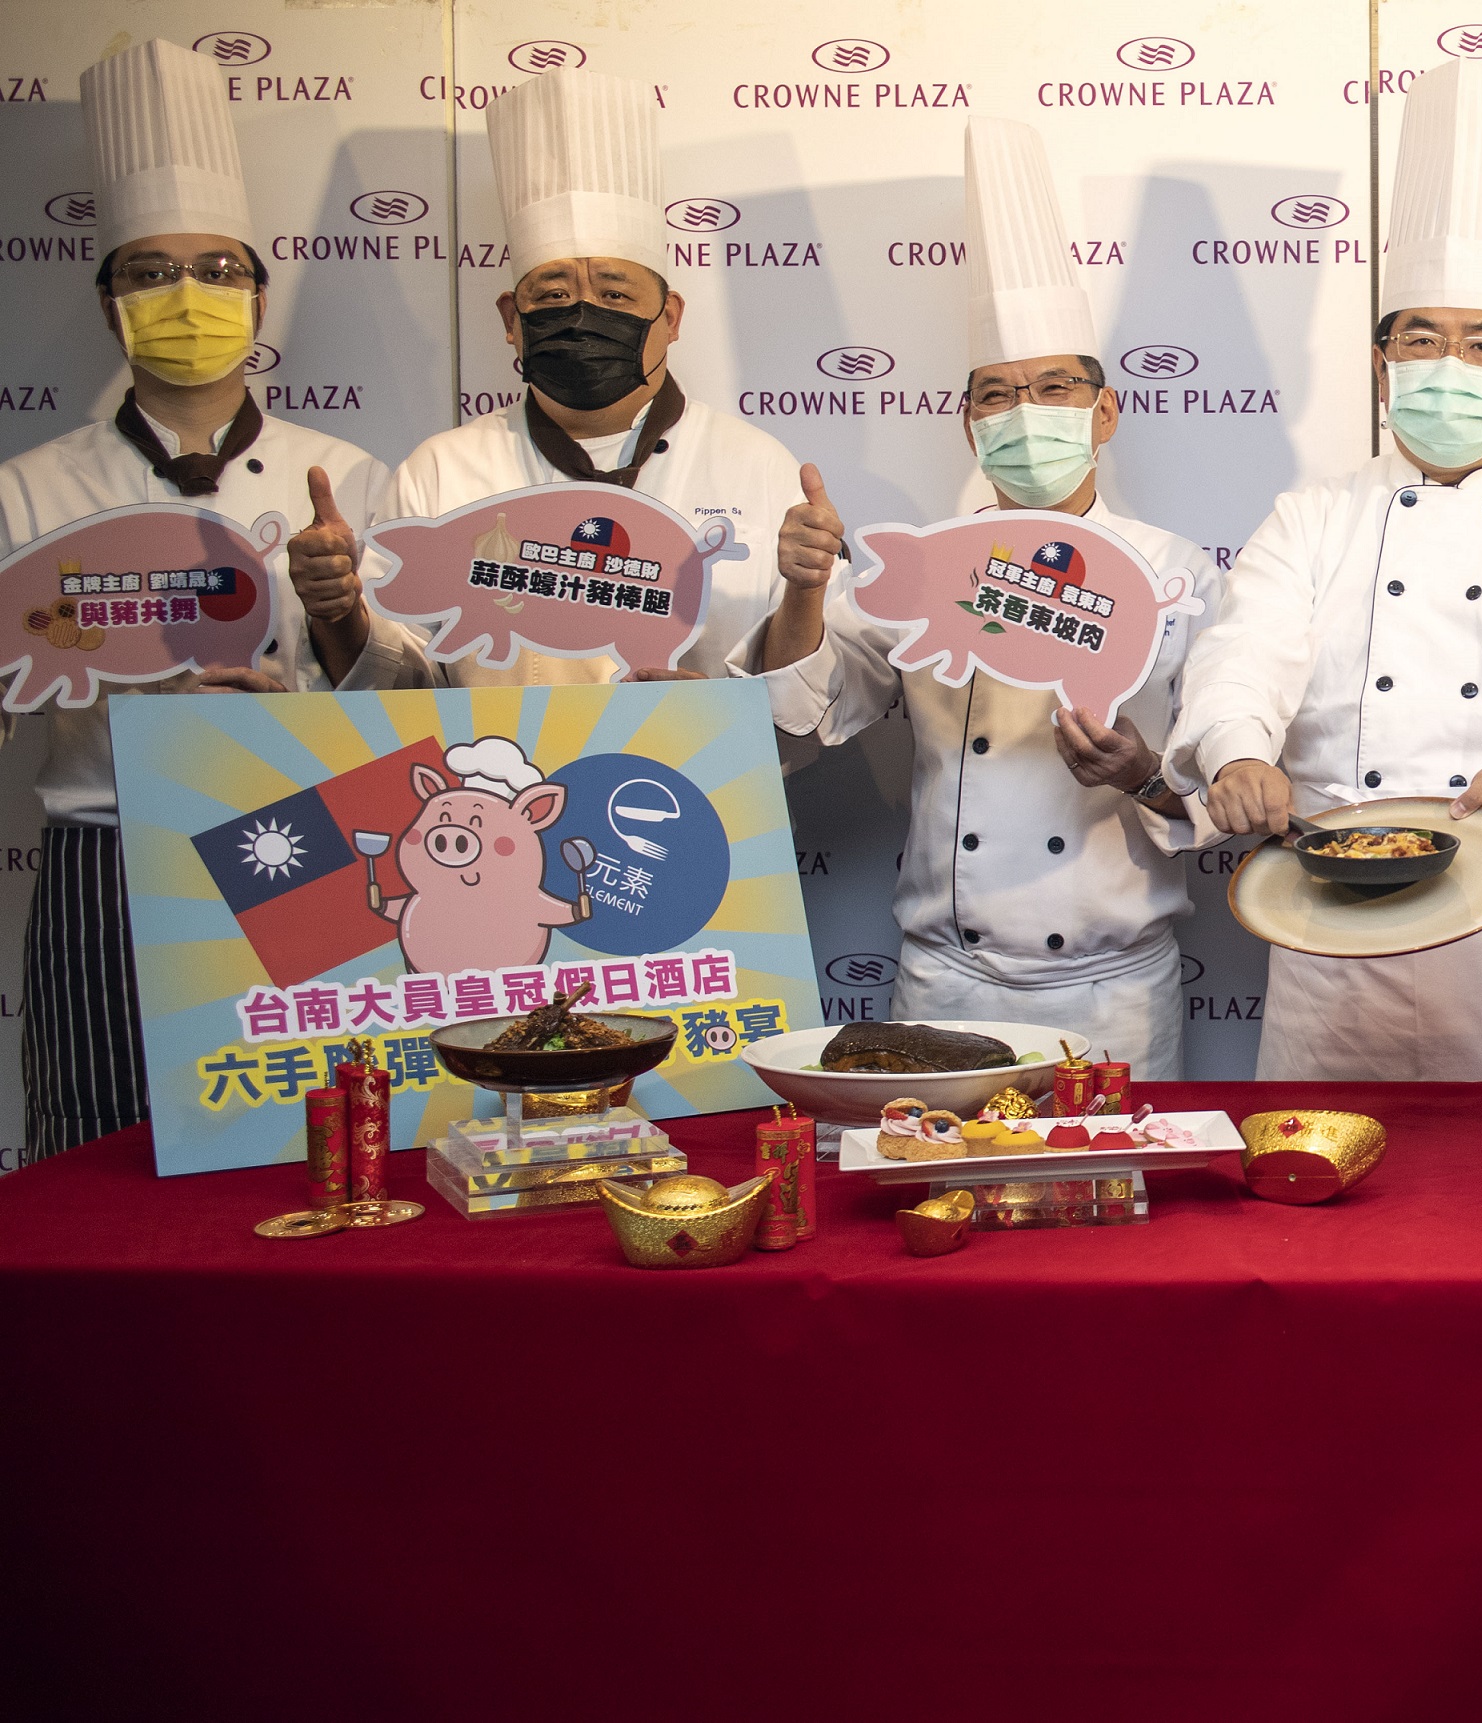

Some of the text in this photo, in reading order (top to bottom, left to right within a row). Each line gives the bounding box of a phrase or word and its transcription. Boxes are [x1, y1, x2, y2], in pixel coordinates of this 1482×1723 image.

[734, 84, 859, 108] CROWNE
[1038, 83, 1164, 106] CROWNE
[272, 236, 399, 260] CROWNE
[1192, 240, 1319, 264] CROWNE
[739, 392, 865, 415] CROWNE
[521, 541, 661, 581] 歐巴主廚 沙德財
[469, 559, 672, 616] 蒜酥蠔汁豬棒腿
[986, 559, 1114, 617] 冠軍主廚 袁東海
[80, 597, 199, 627] 與豬共舞
[975, 585, 1105, 652] 茶香東坡肉
[586, 853, 654, 900] 元素
[244, 953, 733, 1036] 台南大員皇冠假日酒店
